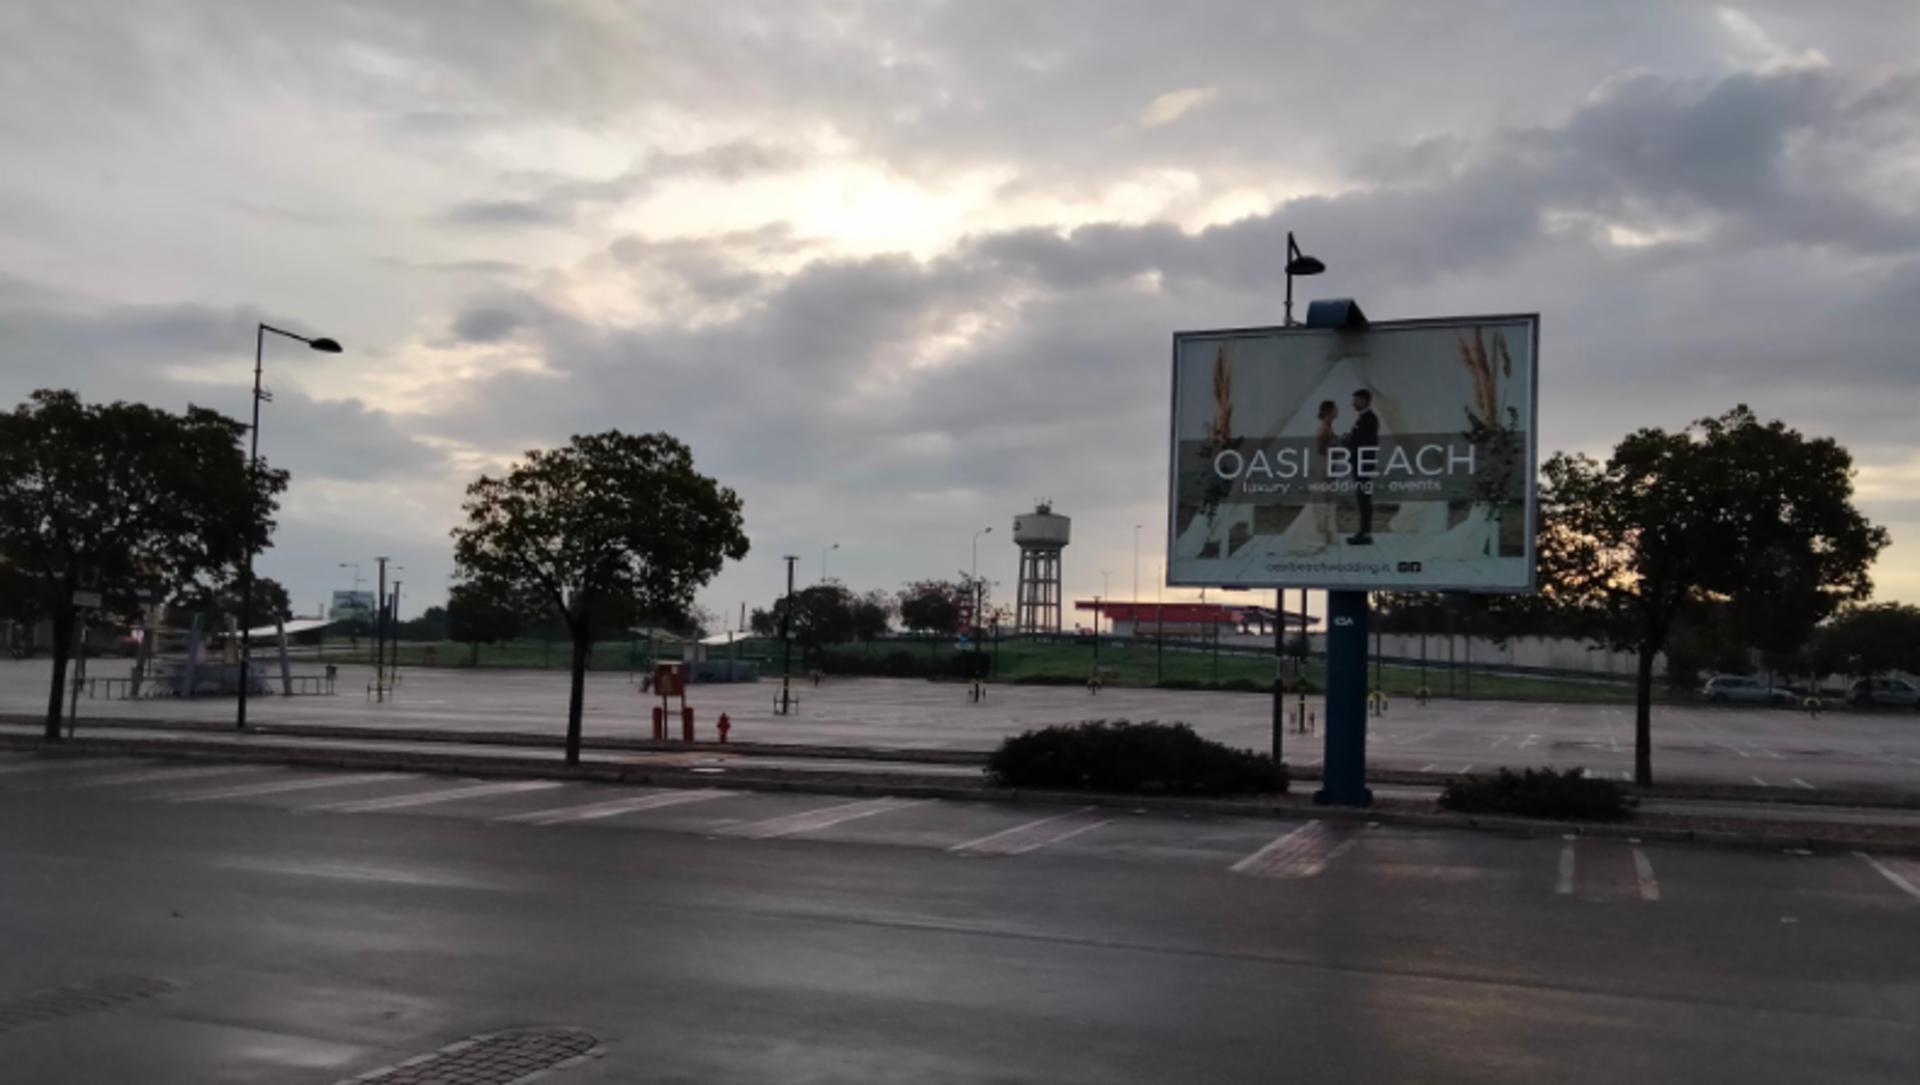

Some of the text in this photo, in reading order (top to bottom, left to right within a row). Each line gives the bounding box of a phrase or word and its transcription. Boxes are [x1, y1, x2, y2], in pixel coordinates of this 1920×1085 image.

[1213, 444, 1476, 480] OASI BEACH
[1242, 481, 1291, 495] luxury
[1308, 478, 1374, 495] wedding
[1388, 479, 1442, 492] events
